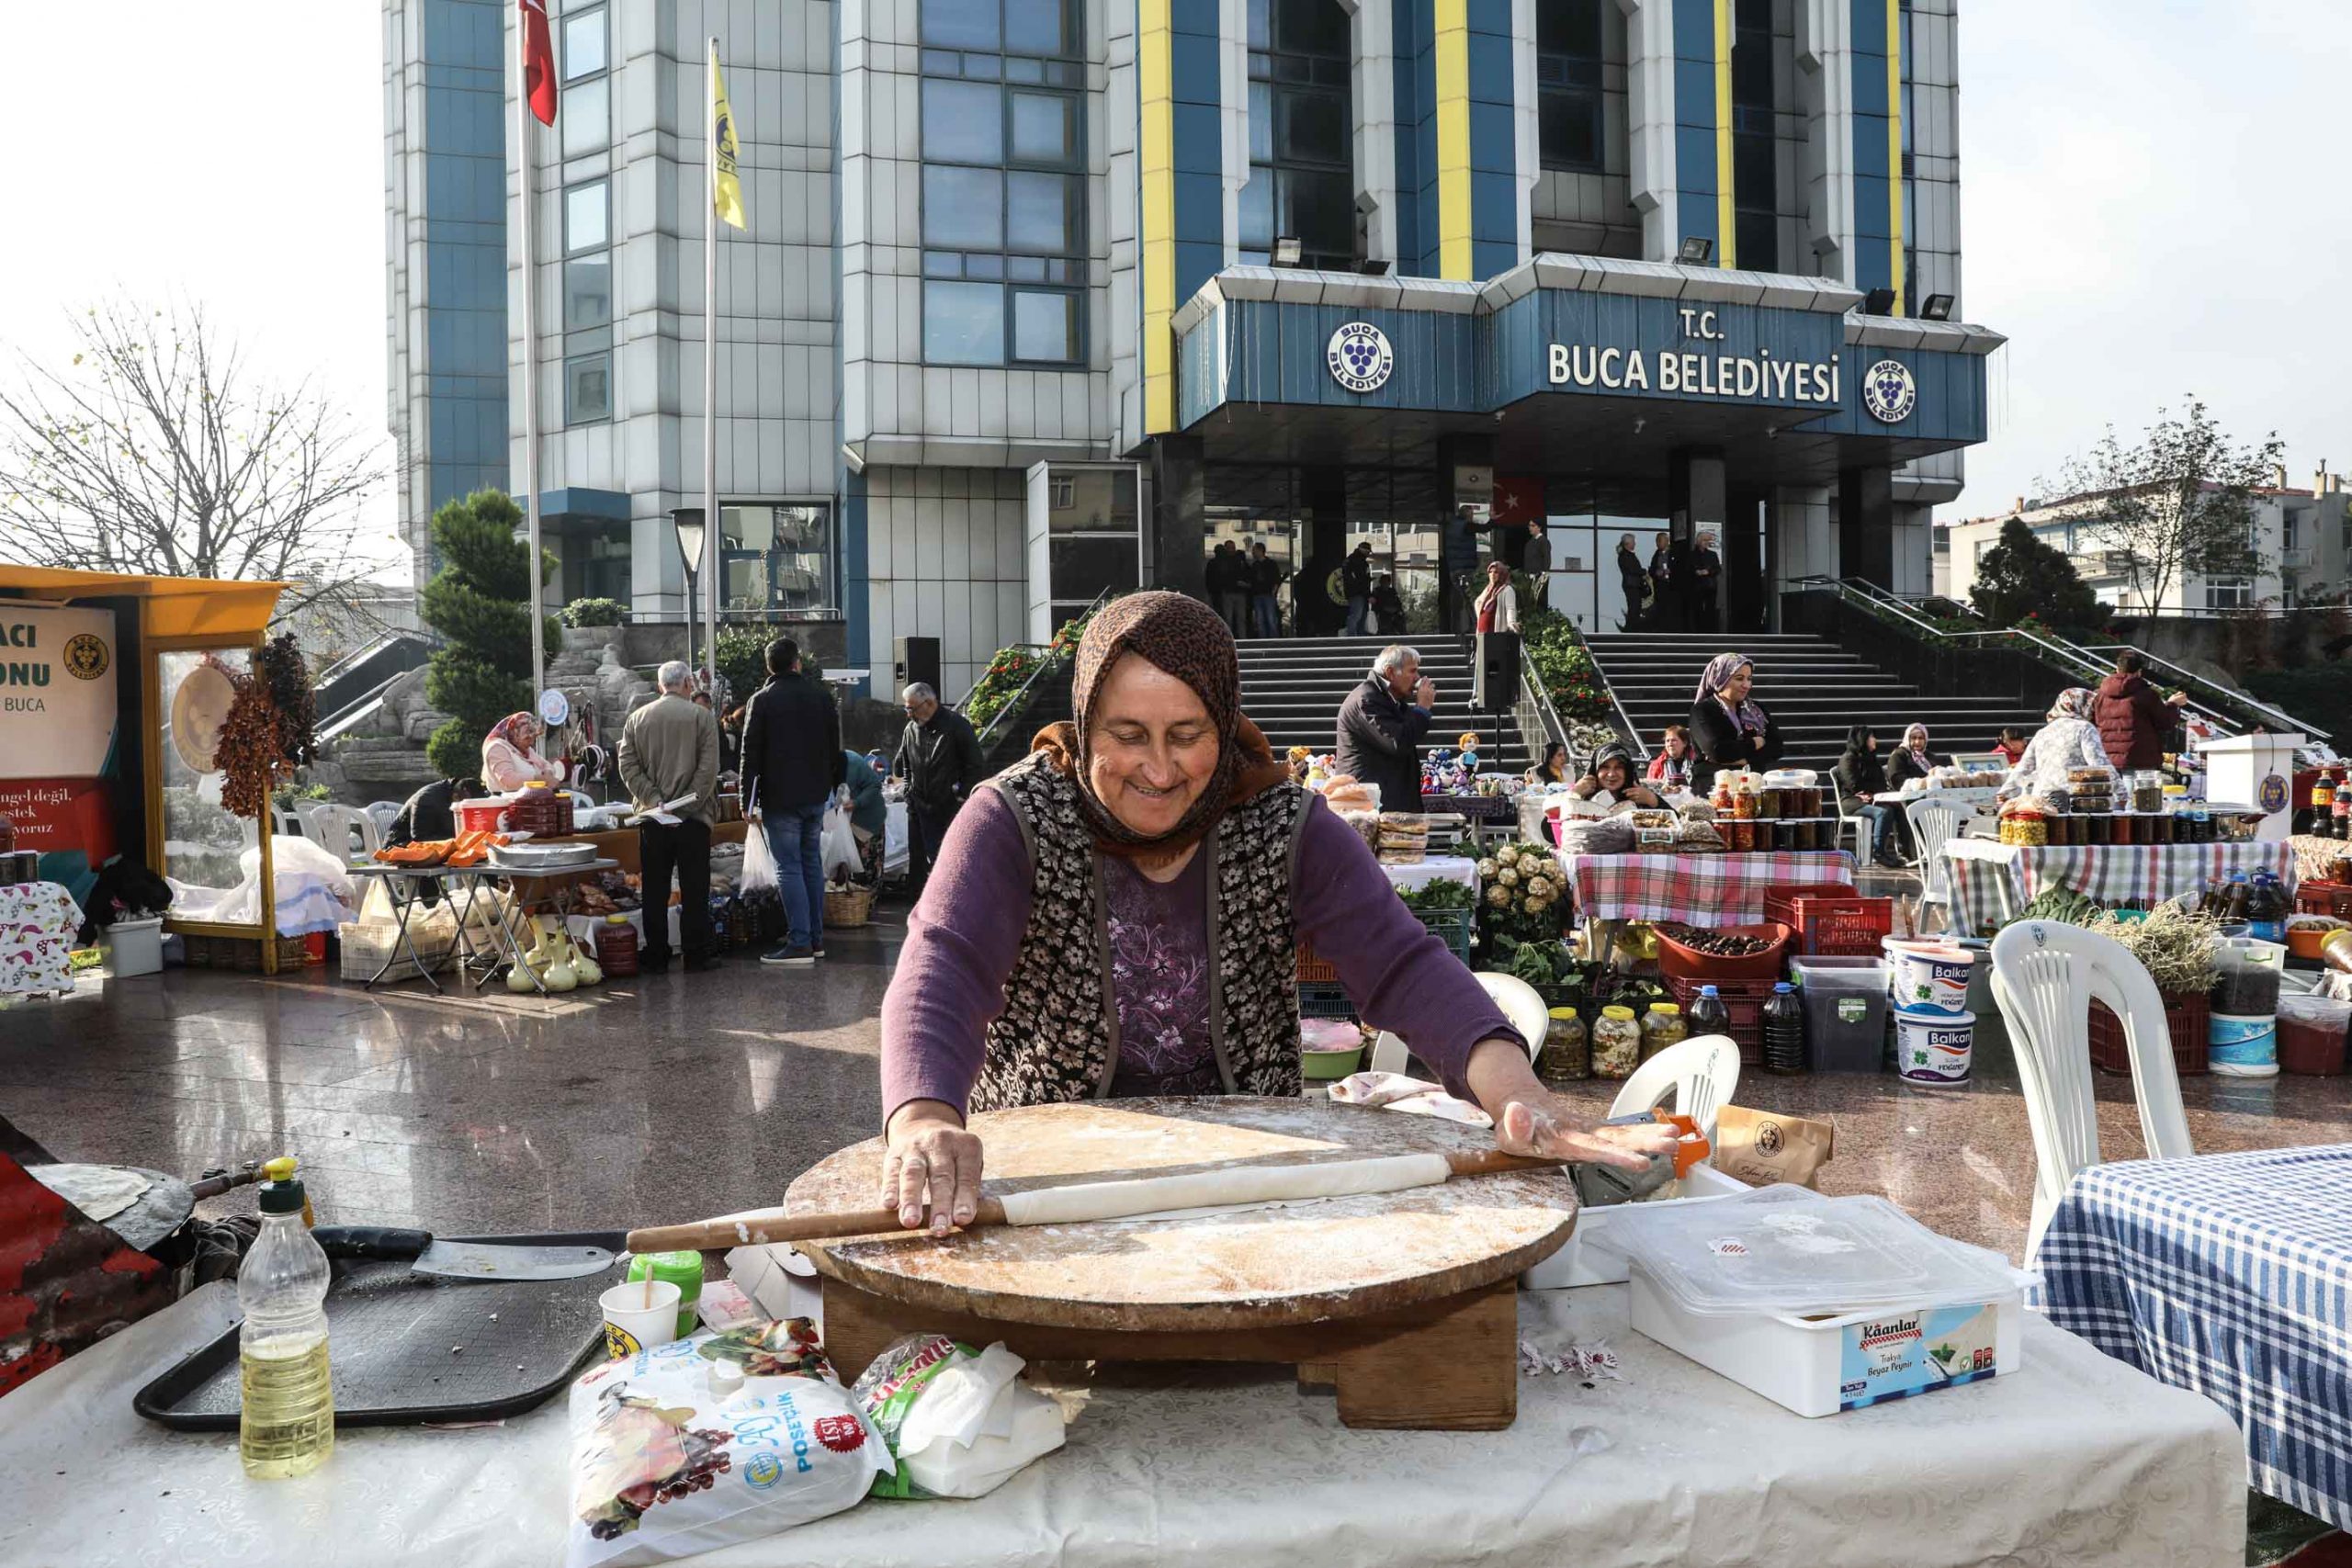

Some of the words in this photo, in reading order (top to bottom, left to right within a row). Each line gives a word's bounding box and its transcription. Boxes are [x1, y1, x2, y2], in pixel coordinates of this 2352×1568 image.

[1340, 324, 1379, 341] BUCA
[1679, 309, 1724, 339] T.C.
[1548, 343, 1649, 390] BUCA
[1658, 348, 1839, 403] BELEDİYESİ
[1874, 362, 1905, 376] BUCA
[5, 697, 45, 712] BUCA
[0, 788, 31, 807] ngel
[1930, 1032, 1971, 1044] Balkan
[1880, 1353, 1902, 1364] Trakya
[1867, 1366, 1889, 1378] Beyaz
[1891, 1360, 1913, 1373] Peynir
